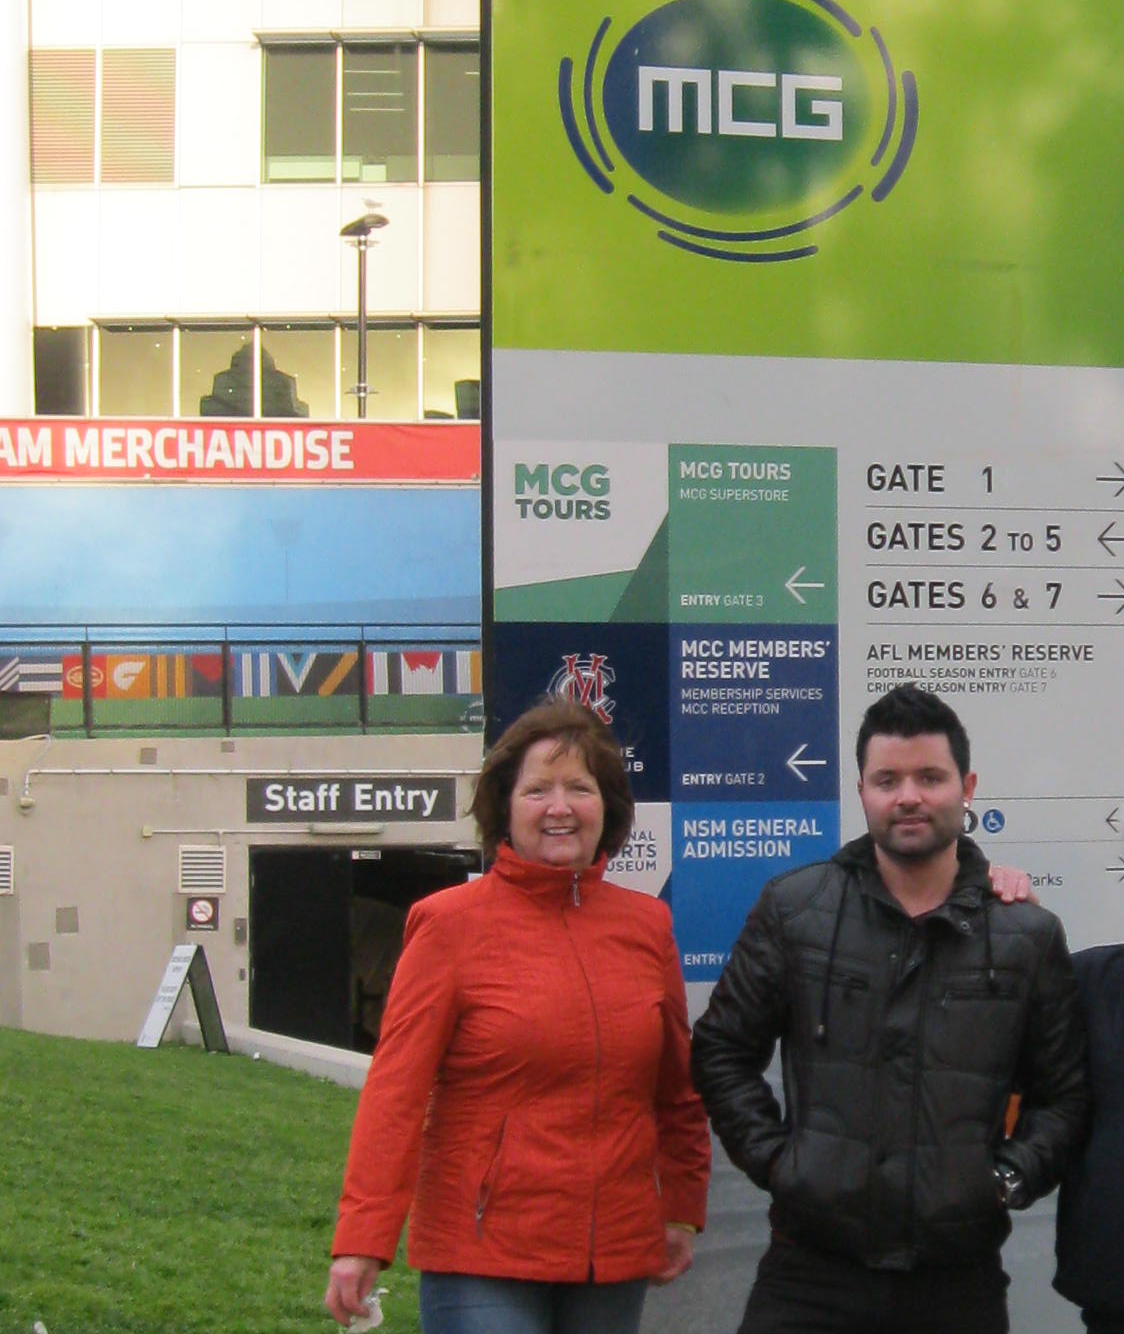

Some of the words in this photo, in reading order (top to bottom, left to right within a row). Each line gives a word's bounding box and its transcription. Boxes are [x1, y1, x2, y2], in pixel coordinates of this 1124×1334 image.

[638, 66, 843, 141] MCG
[65, 428, 354, 469] MERCHANDISE
[679, 460, 723, 480] MCG
[728, 461, 792, 481] TOURS
[867, 464, 945, 492] GATE
[981, 466, 993, 493] 1
[514, 463, 611, 497] MCG
[679, 488, 707, 501] MCG
[709, 488, 789, 502] SUPERSTORE
[514, 498, 611, 520] TOURS
[867, 522, 966, 550] GATES
[980, 524, 997, 551] 2
[1007, 532, 1034, 551] TO
[1046, 525, 1062, 552] 5
[680, 594, 721, 606] ENTRY
[724, 594, 754, 606] GATE
[756, 595, 764, 607] 3
[867, 581, 966, 609] GATES
[981, 582, 997, 609] 6
[1013, 587, 1030, 609] &
[1046, 583, 1062, 609] 7
[681, 640, 724, 657] MCC
[867, 644, 902, 661] AFL
[1012, 645, 1094, 661] RESERVE
[681, 661, 770, 679] RESERVE
[867, 667, 927, 678] FOOTBALL
[929, 668, 976, 678] SEASON
[979, 668, 1016, 679] ENTRY
[1019, 668, 1047, 679] GATE
[681, 688, 763, 700] MEMBERSHIP
[765, 688, 823, 700] SERVICES
[920, 682, 966, 693] SEASON
[969, 682, 1007, 693] ENTRY
[1009, 682, 1040, 693] GATE
[1041, 682, 1048, 693] 7
[681, 703, 709, 714] MCC
[711, 703, 780, 714] RECEPTION
[682, 773, 722, 785] ENTRY
[725, 773, 756, 785] GATE
[758, 773, 765, 785] 2
[265, 783, 340, 811] Staff
[354, 783, 439, 817] Entry
[683, 820, 726, 837] NSM
[732, 819, 823, 836] GENERAL
[622, 844, 656, 858] RTS
[683, 840, 791, 858] ADMISSION
[606, 861, 657, 872] USEUM
[684, 953, 724, 965] ENTRY
